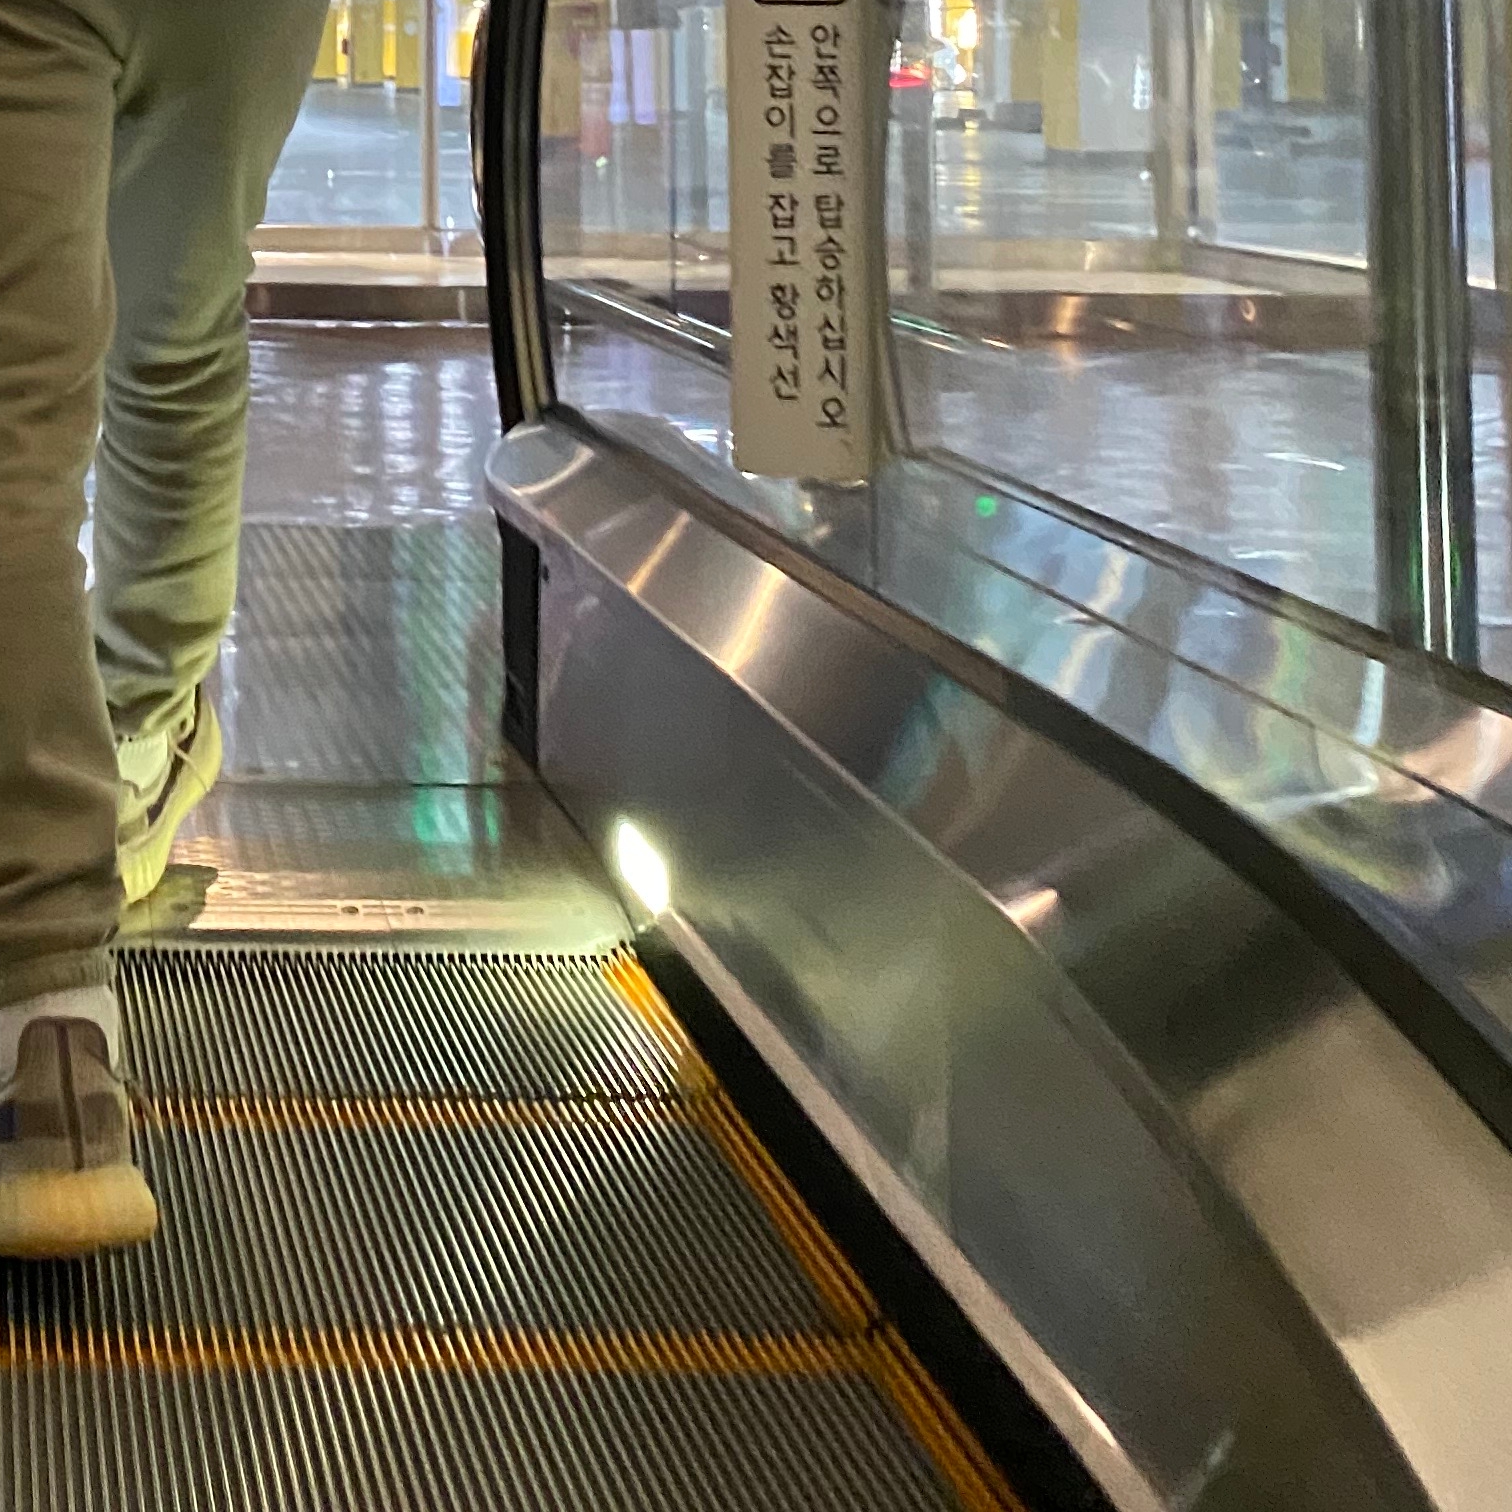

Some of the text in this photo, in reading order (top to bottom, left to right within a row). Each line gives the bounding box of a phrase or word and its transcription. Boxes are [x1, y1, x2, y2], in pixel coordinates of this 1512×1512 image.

[764, 24, 801, 401] 손잡이를 잡고 황색선
[810, 23, 849, 429] 안쪽으로 탑승하십시오
